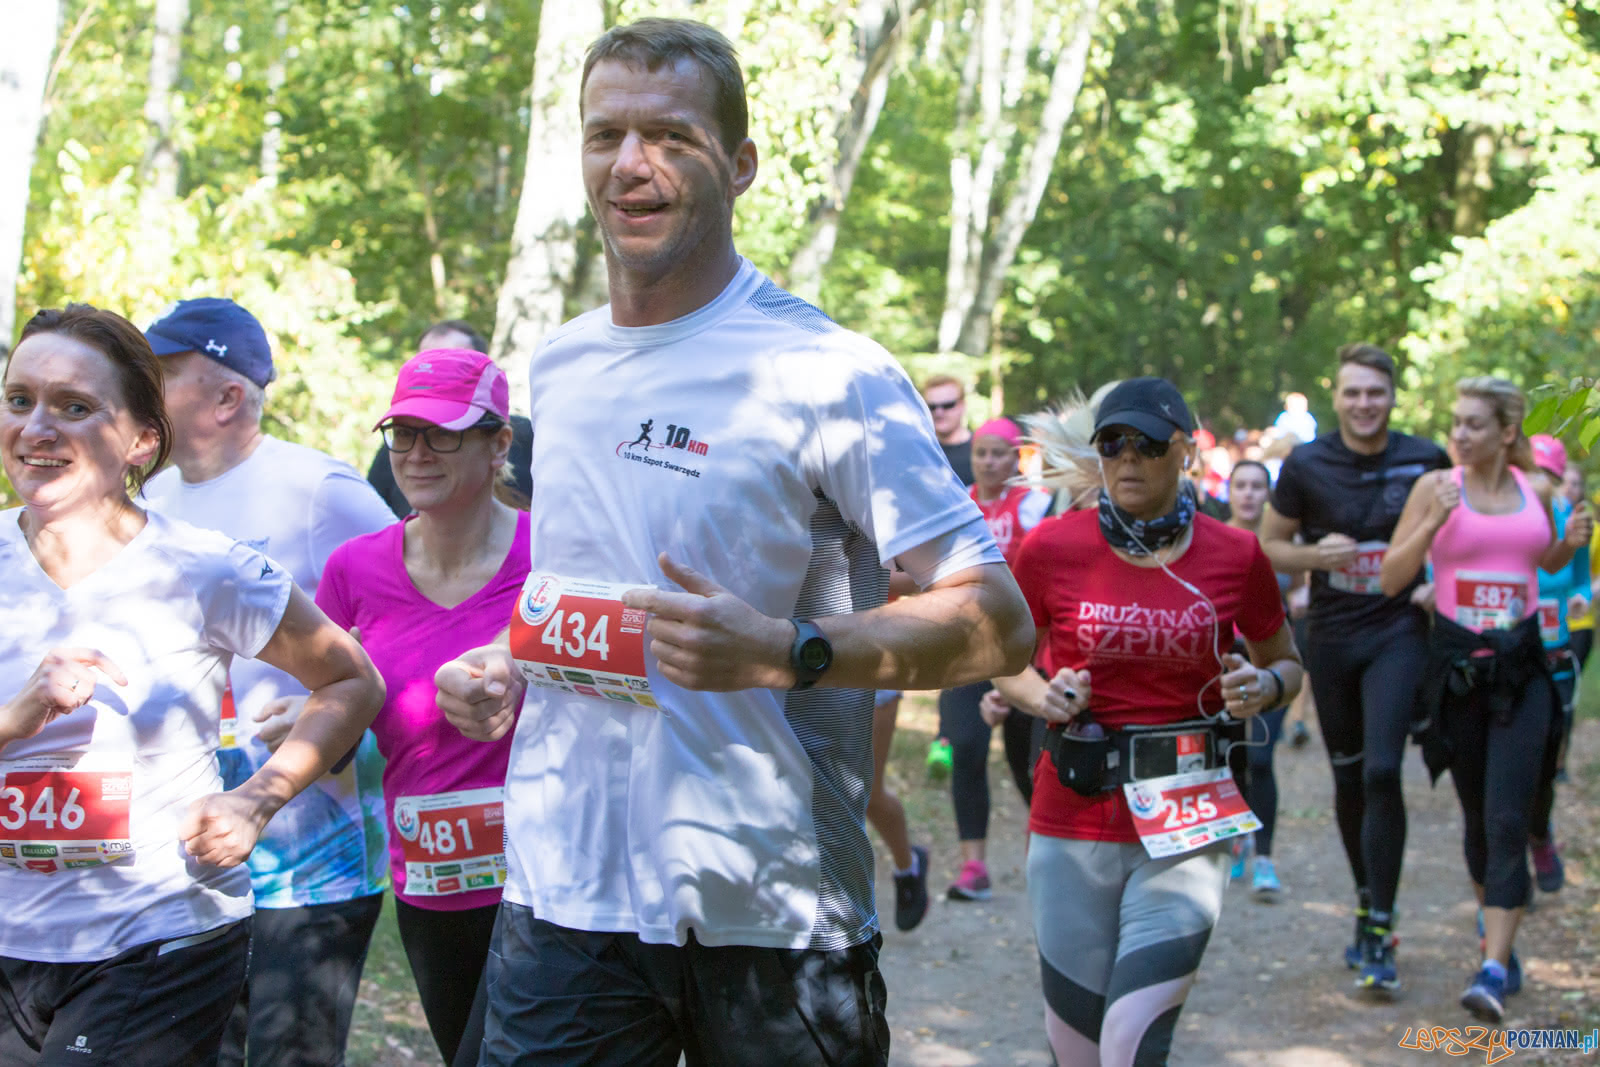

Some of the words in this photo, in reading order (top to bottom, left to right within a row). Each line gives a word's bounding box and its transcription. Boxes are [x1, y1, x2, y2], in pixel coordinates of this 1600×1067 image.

[665, 424, 690, 449] 10
[631, 453, 642, 462] km
[643, 456, 663, 467] Szpot
[664, 461, 700, 478] Swarzędz
[1473, 585, 1513, 607] 587
[1078, 602, 1194, 629] DRUŻYNA
[541, 609, 610, 661] 434
[1077, 624, 1213, 658] SZPIKU
[0, 787, 86, 830] 346
[1163, 792, 1218, 829] 255
[419, 818, 474, 855] 481
